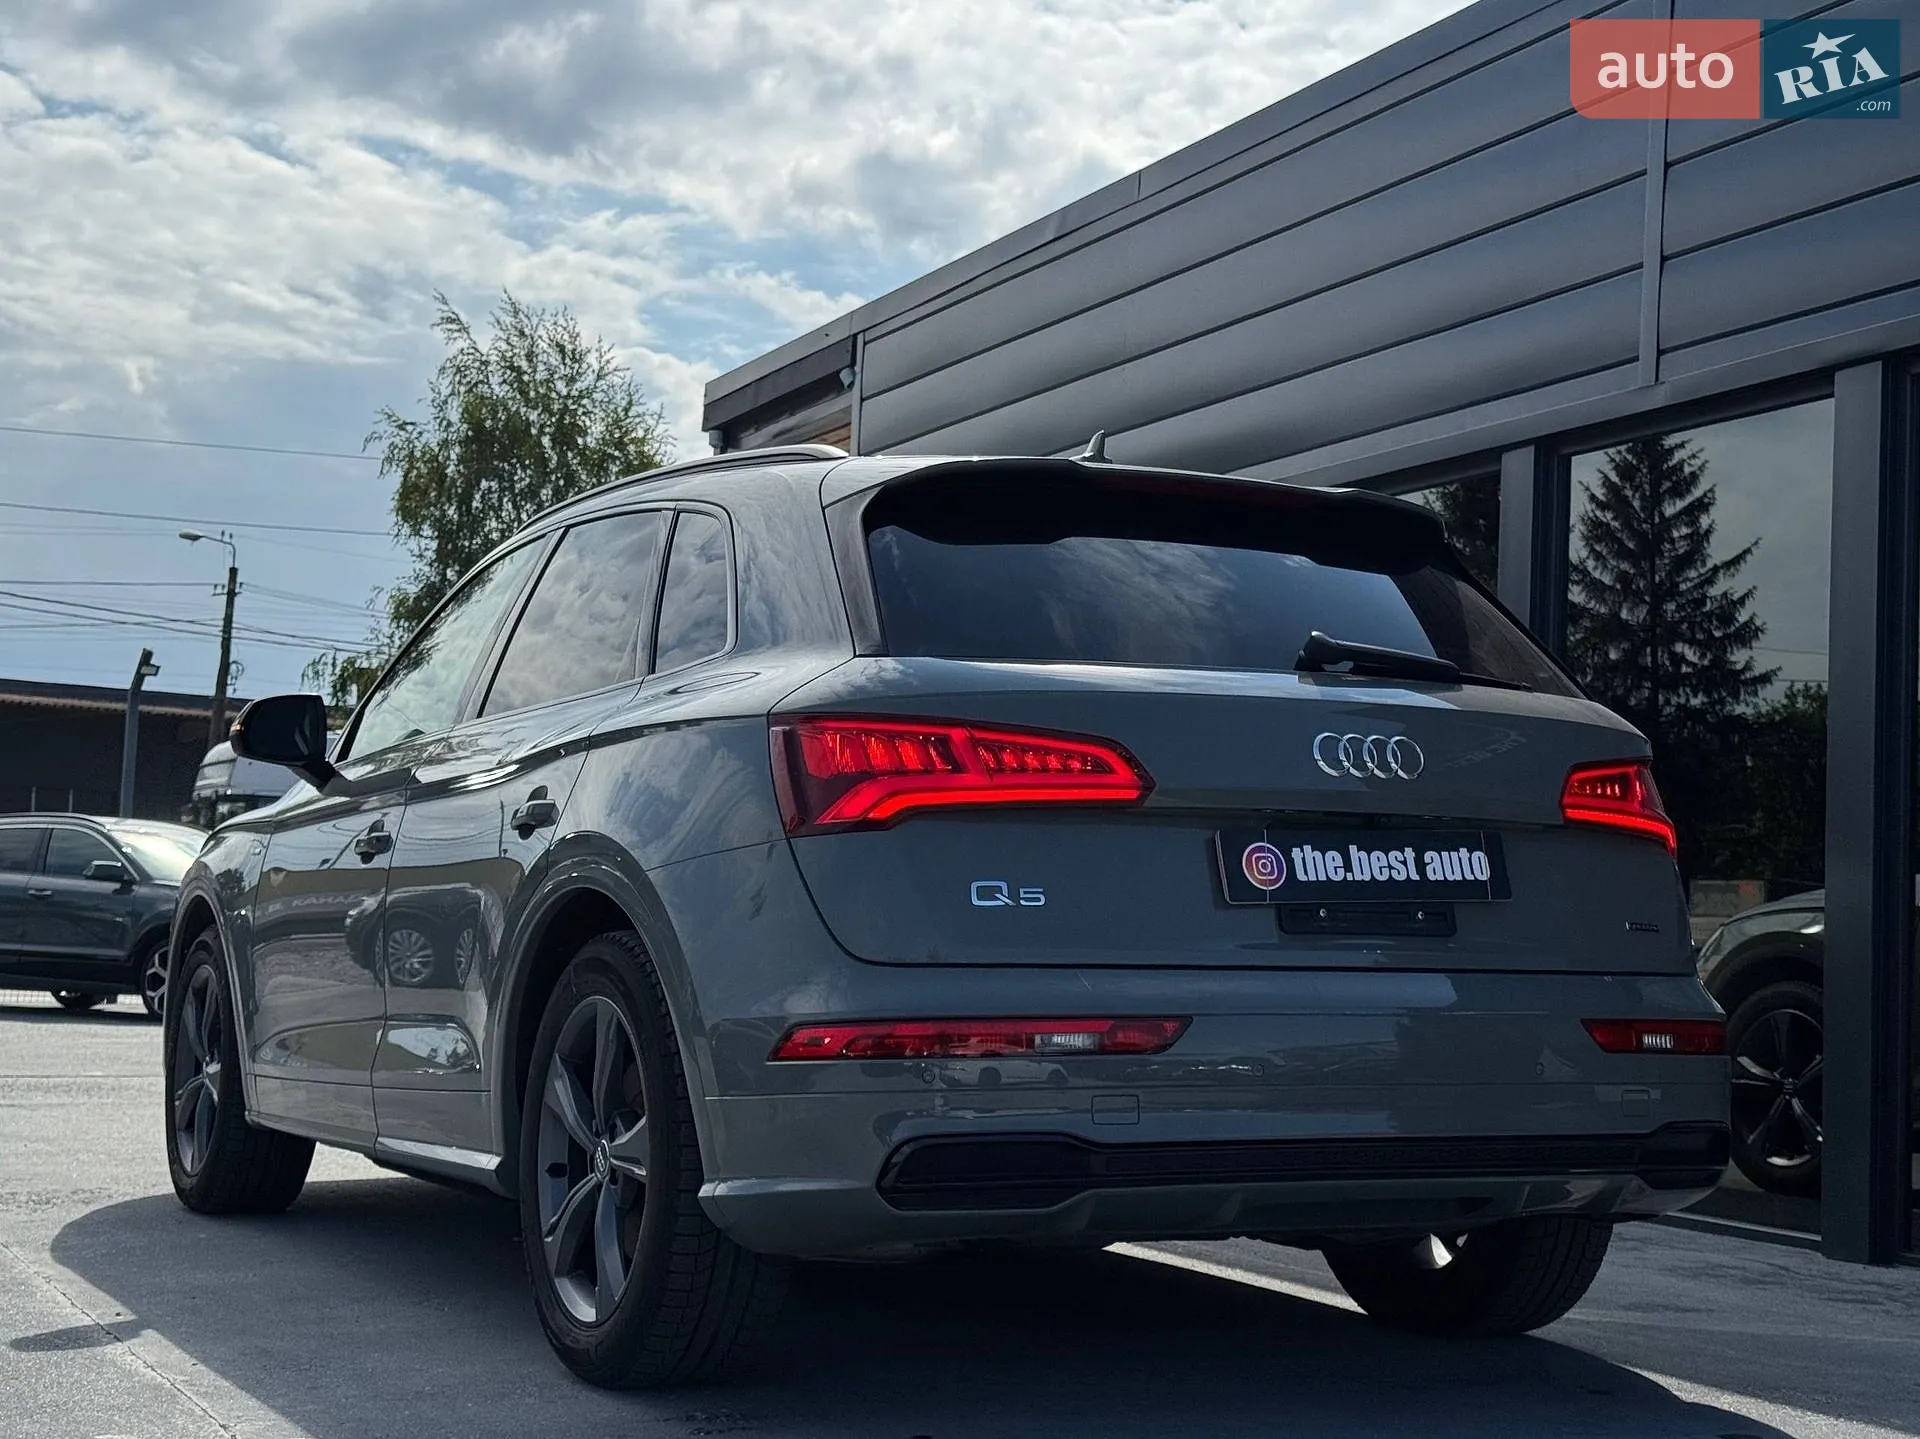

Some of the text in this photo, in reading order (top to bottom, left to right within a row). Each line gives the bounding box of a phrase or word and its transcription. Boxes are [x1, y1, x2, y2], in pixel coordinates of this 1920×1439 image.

[1291, 844, 1491, 882] the.best auto
[970, 880, 1047, 907] Q5
